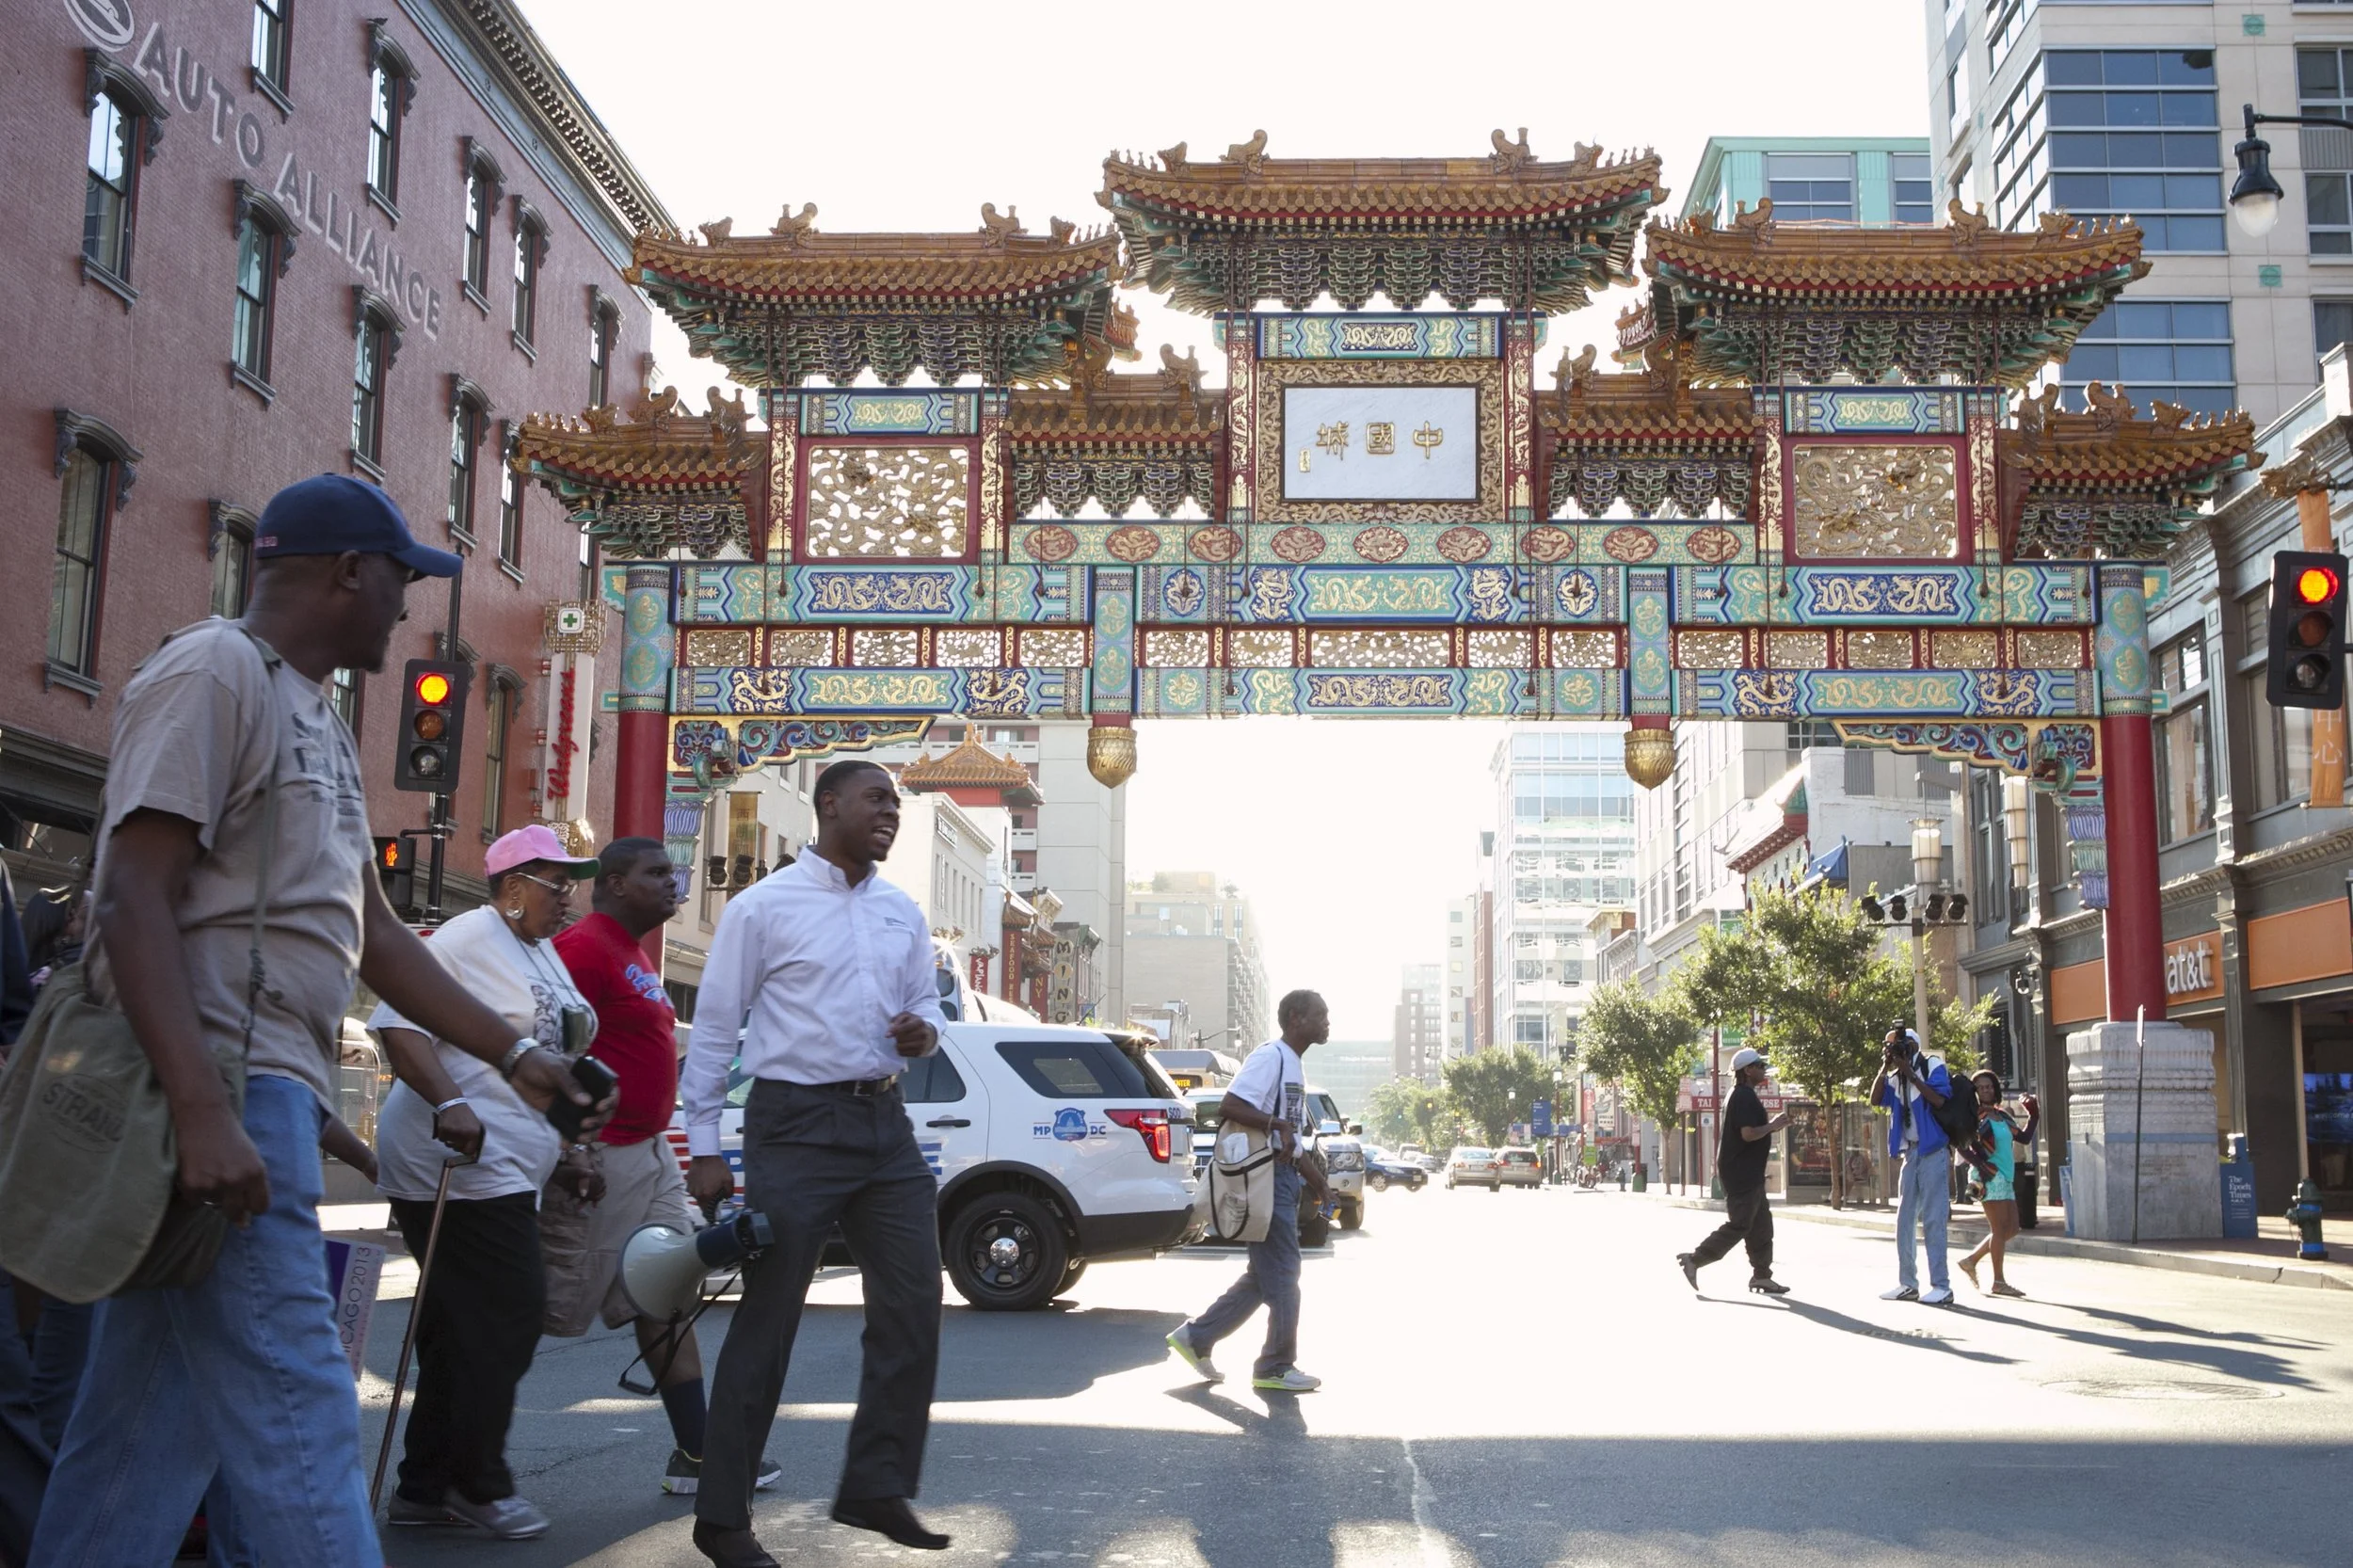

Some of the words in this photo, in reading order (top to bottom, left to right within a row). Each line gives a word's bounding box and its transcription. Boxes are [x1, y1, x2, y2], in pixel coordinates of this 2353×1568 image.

[133, 23, 264, 168] AUTO
[273, 153, 440, 342] ALLIANCE
[547, 666, 580, 800] Walgreens
[1008, 933, 1016, 980] SEAFOOD
[1698, 1098, 1713, 1108] TAI
[1033, 1126, 1051, 1136] MP
[1090, 1125, 1107, 1135] DC
[2229, 1183, 2251, 1192] Epoch
[2229, 1191, 2251, 1199] Times
[351, 1247, 372, 1286] 2013
